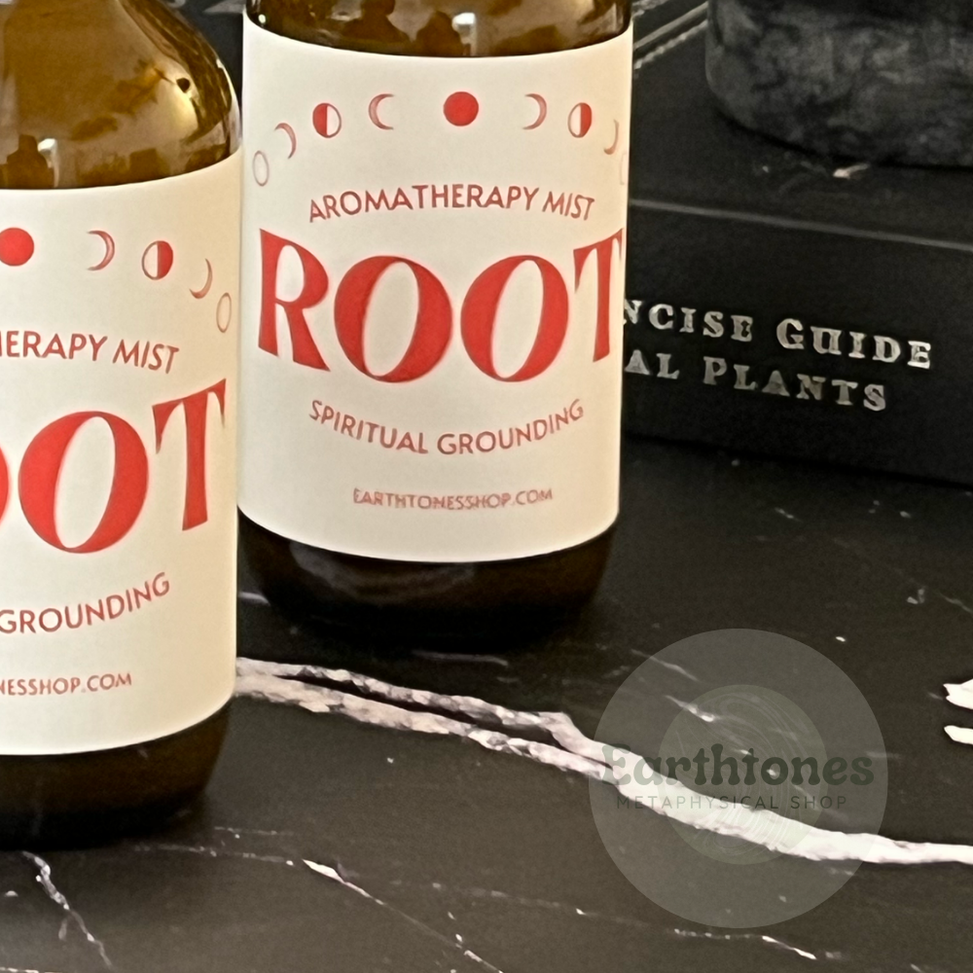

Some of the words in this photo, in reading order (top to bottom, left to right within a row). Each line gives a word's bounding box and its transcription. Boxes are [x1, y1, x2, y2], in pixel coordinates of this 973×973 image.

[309, 183, 540, 223] AROMATHERAPY
[543, 190, 596, 222] MIST
[257, 228, 624, 384] ROOT
[112, 338, 180, 374] MIST
[702, 356, 887, 411] PLANTS
[308, 399, 429, 455] SPIRITUAL
[436, 398, 585, 455] GROUNDING
[352, 487, 554, 510] EARTHTONESSHOP.COM
